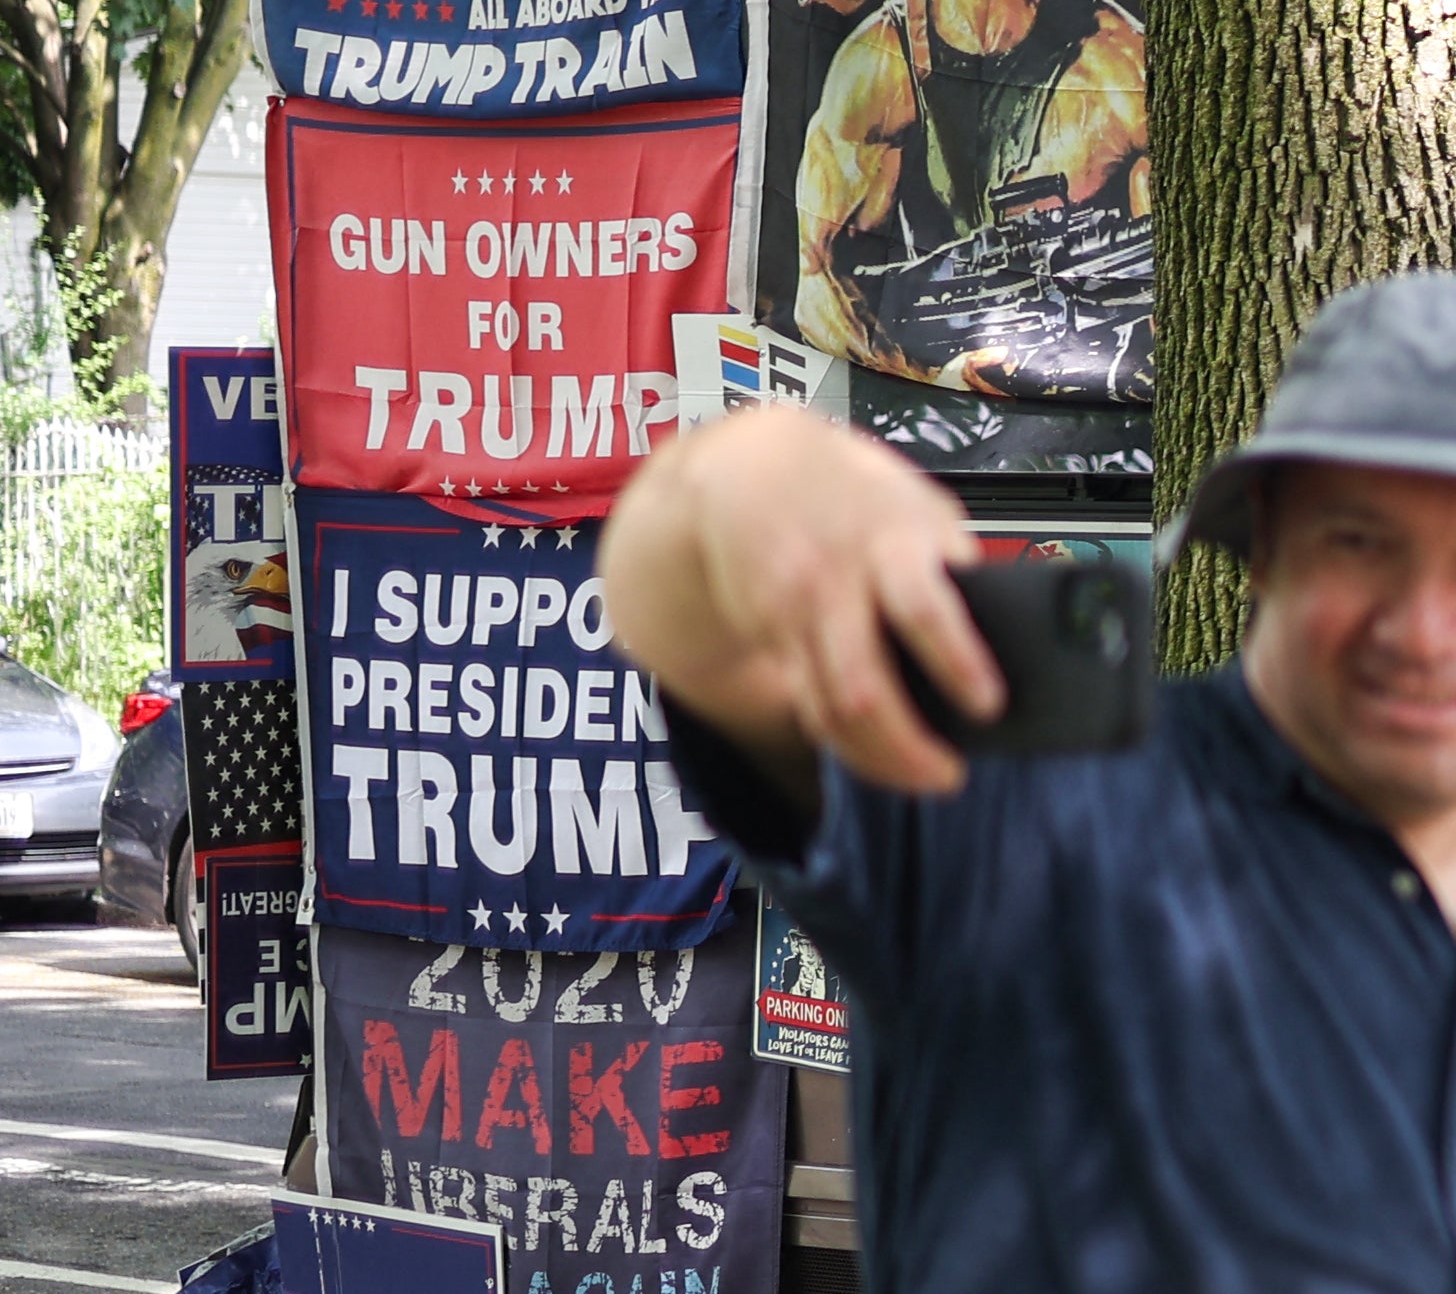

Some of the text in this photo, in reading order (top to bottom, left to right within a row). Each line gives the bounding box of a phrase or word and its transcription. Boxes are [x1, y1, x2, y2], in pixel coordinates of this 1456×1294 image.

[293, 11, 695, 106] TRUMP TRAIN
[330, 213, 697, 278] GUN OWNERS
[468, 303, 563, 350] FOR
[355, 365, 679, 458] TRUMP
[332, 568, 616, 651] I SUPPO
[331, 659, 664, 743] PRESIDEN
[221, 891, 297, 916] GREAT!
[409, 937, 696, 1024] 2020
[766, 997, 822, 1023] PARKING
[779, 1027, 828, 1046] VIOLATORS
[363, 1019, 730, 1159] MAKE
